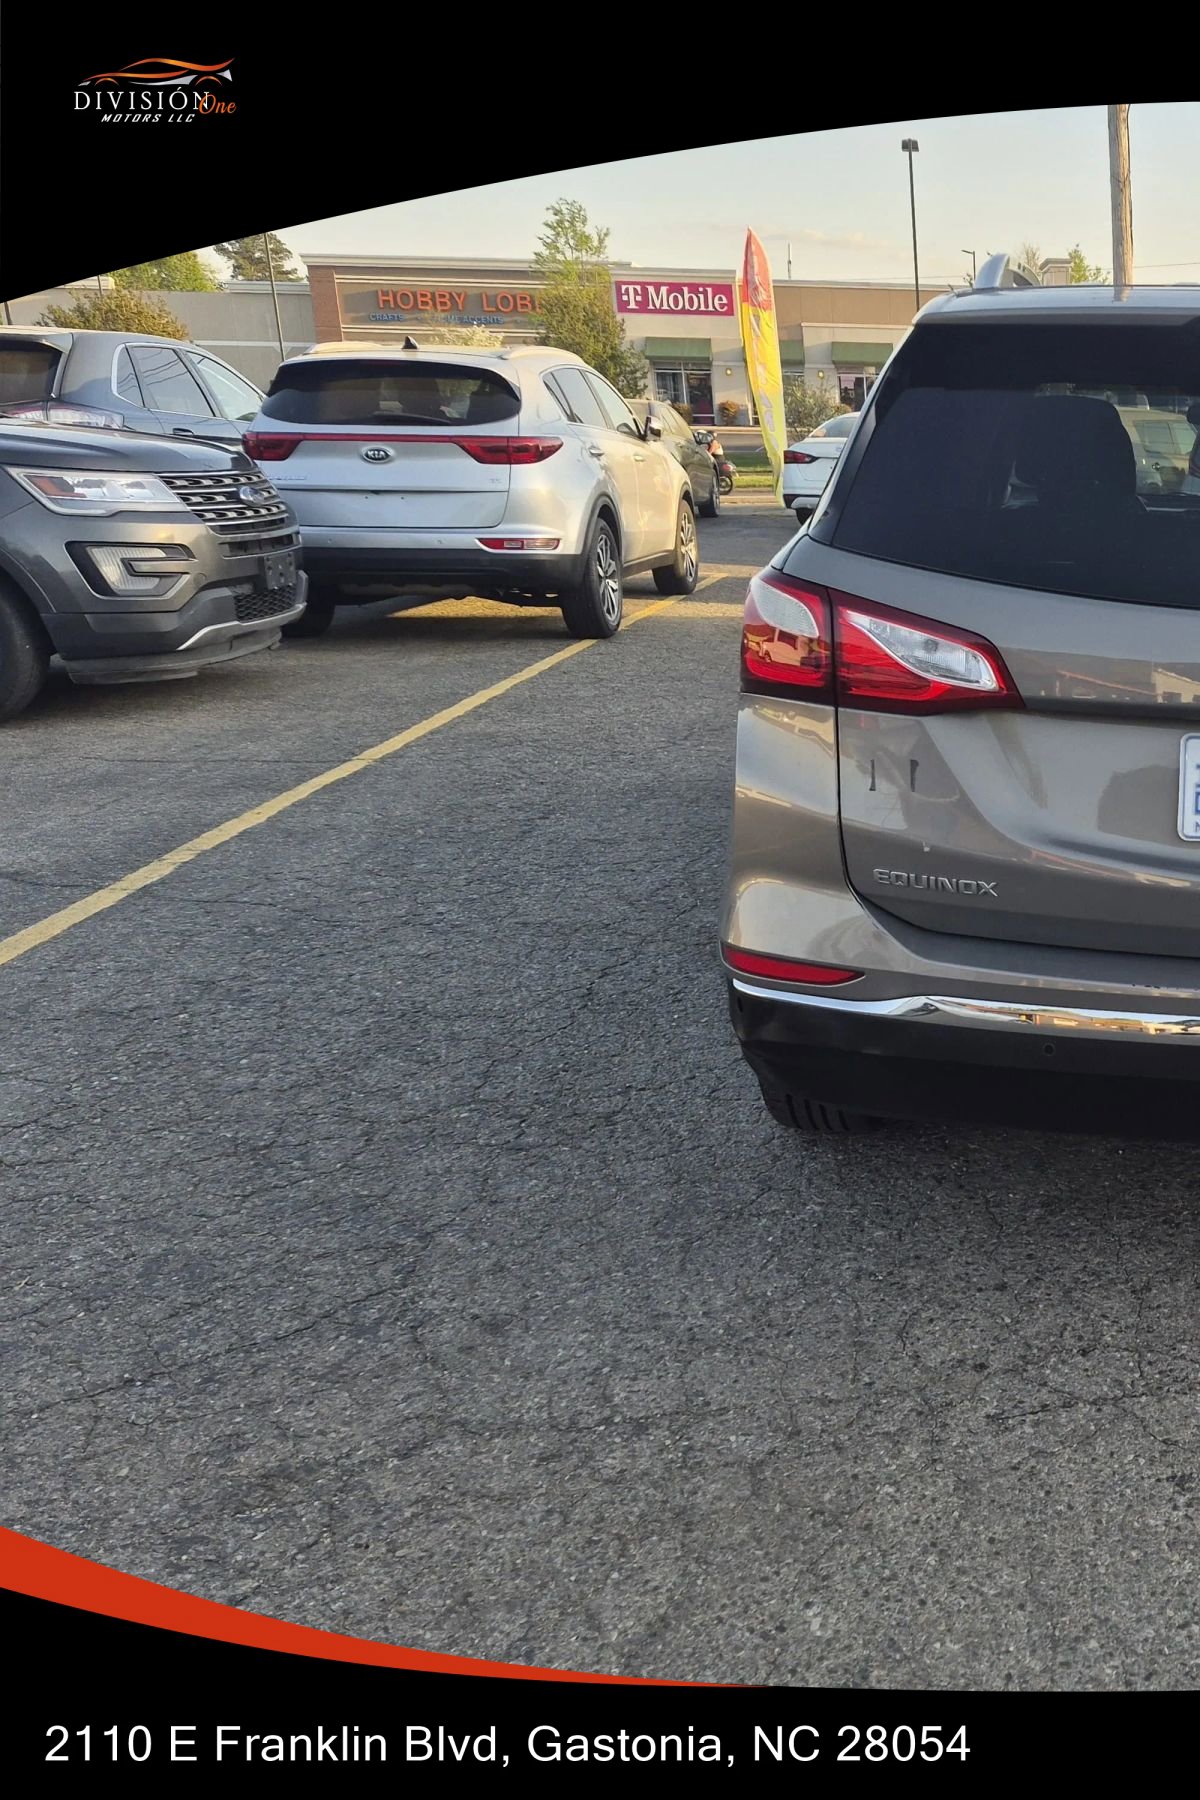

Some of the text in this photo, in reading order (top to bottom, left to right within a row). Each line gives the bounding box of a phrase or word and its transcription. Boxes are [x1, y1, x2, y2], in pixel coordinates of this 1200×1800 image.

[377, 289, 467, 312] HOBBY
[645, 285, 728, 312] Mobile
[369, 313, 405, 322] CRAFTS
[462, 314, 504, 325] ACCENTS
[367, 450, 386, 459] KIA
[872, 868, 998, 897] EQUINOX
